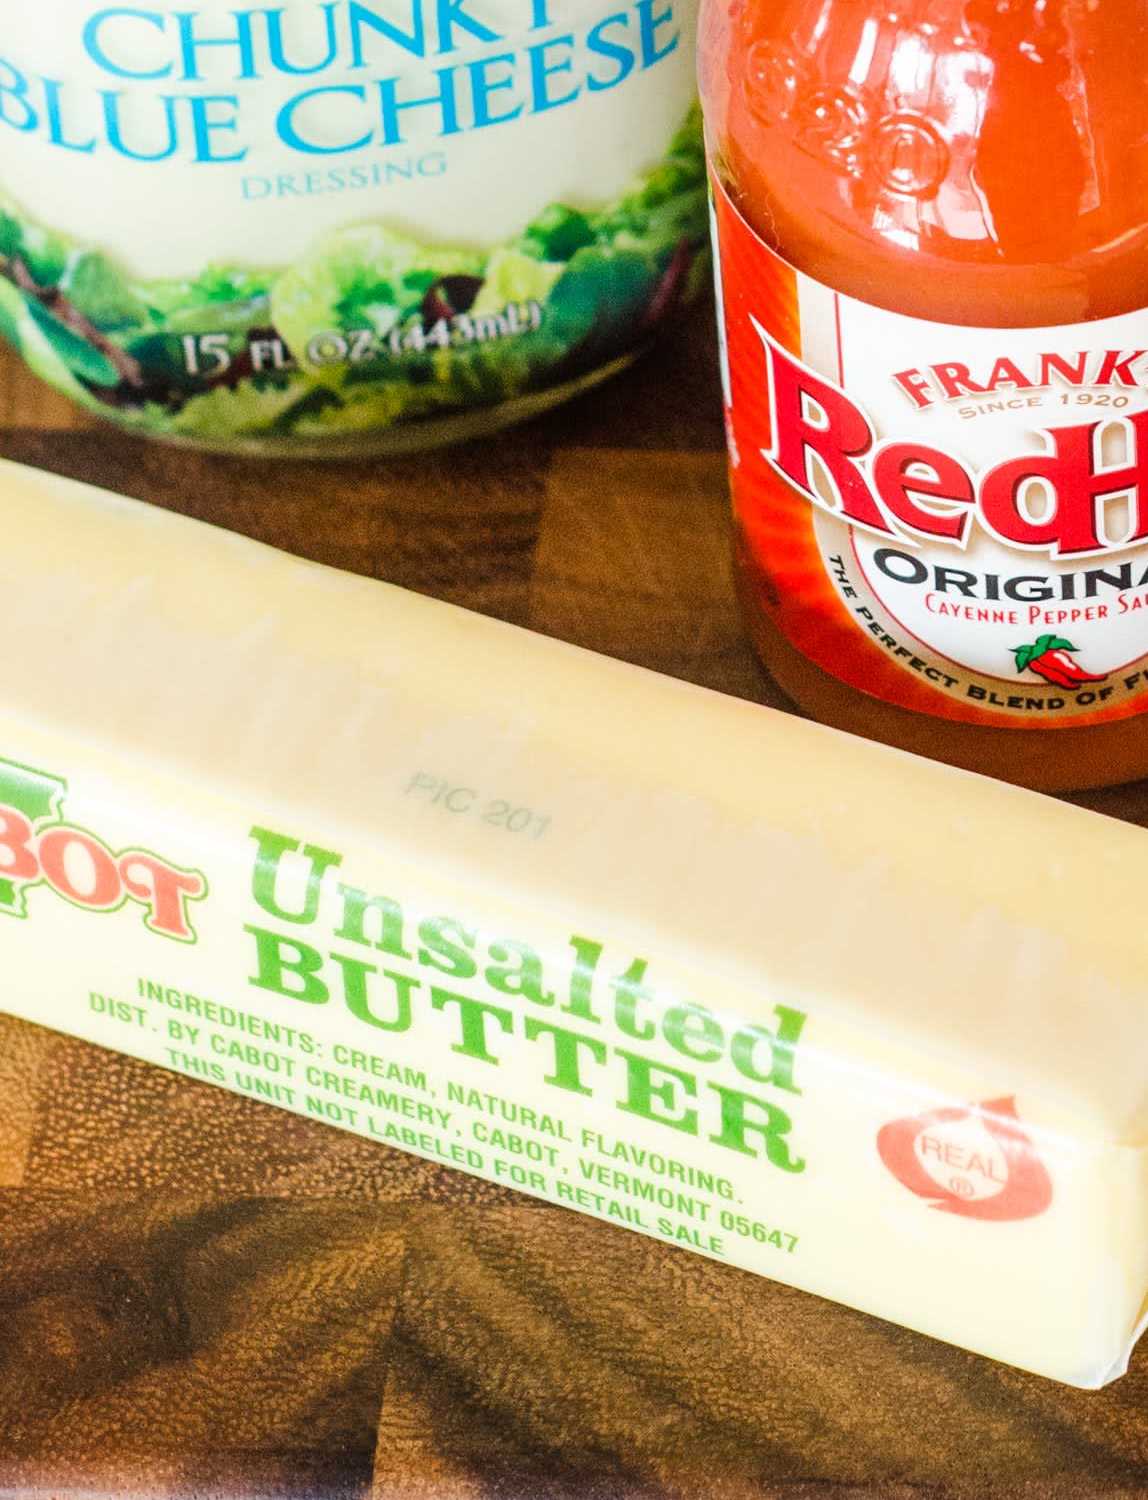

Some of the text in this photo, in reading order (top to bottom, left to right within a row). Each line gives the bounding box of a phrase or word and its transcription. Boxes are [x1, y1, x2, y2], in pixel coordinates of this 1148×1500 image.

[0, 56, 249, 164] BLUE
[240, 152, 448, 202] DRESSING
[182, 332, 232, 376] 15
[958, 393, 1130, 420] SINCE 1920
[829, 554, 858, 599] THE
[855, 606, 960, 688] PERFECT
[966, 684, 1066, 710] BLEND
[1075, 686, 1114, 705] OF
[924, 592, 1019, 625] CAYENNE
[1028, 604, 1108, 626] PEPPER
[404, 771, 479, 814] PIC
[0, 807, 204, 940] BOT
[249, 826, 807, 1096] Unsalted
[137, 978, 744, 1205] INGREDIENTS: CREAM, NATURAL FLAVORING.
[243, 922, 807, 1174] BUTTER
[164, 1046, 726, 1257] THIS UNIT NOT LABELED FOR RETAIL SALE
[167, 1018, 200, 1046] BY
[209, 1032, 297, 1079] CABOT
[305, 1065, 462, 1137] CREAMERY,
[471, 1120, 569, 1176] CABOT,
[578, 1156, 714, 1222] VERMONT
[719, 1209, 800, 1254] 05647
[921, 1134, 1004, 1184] REAL
